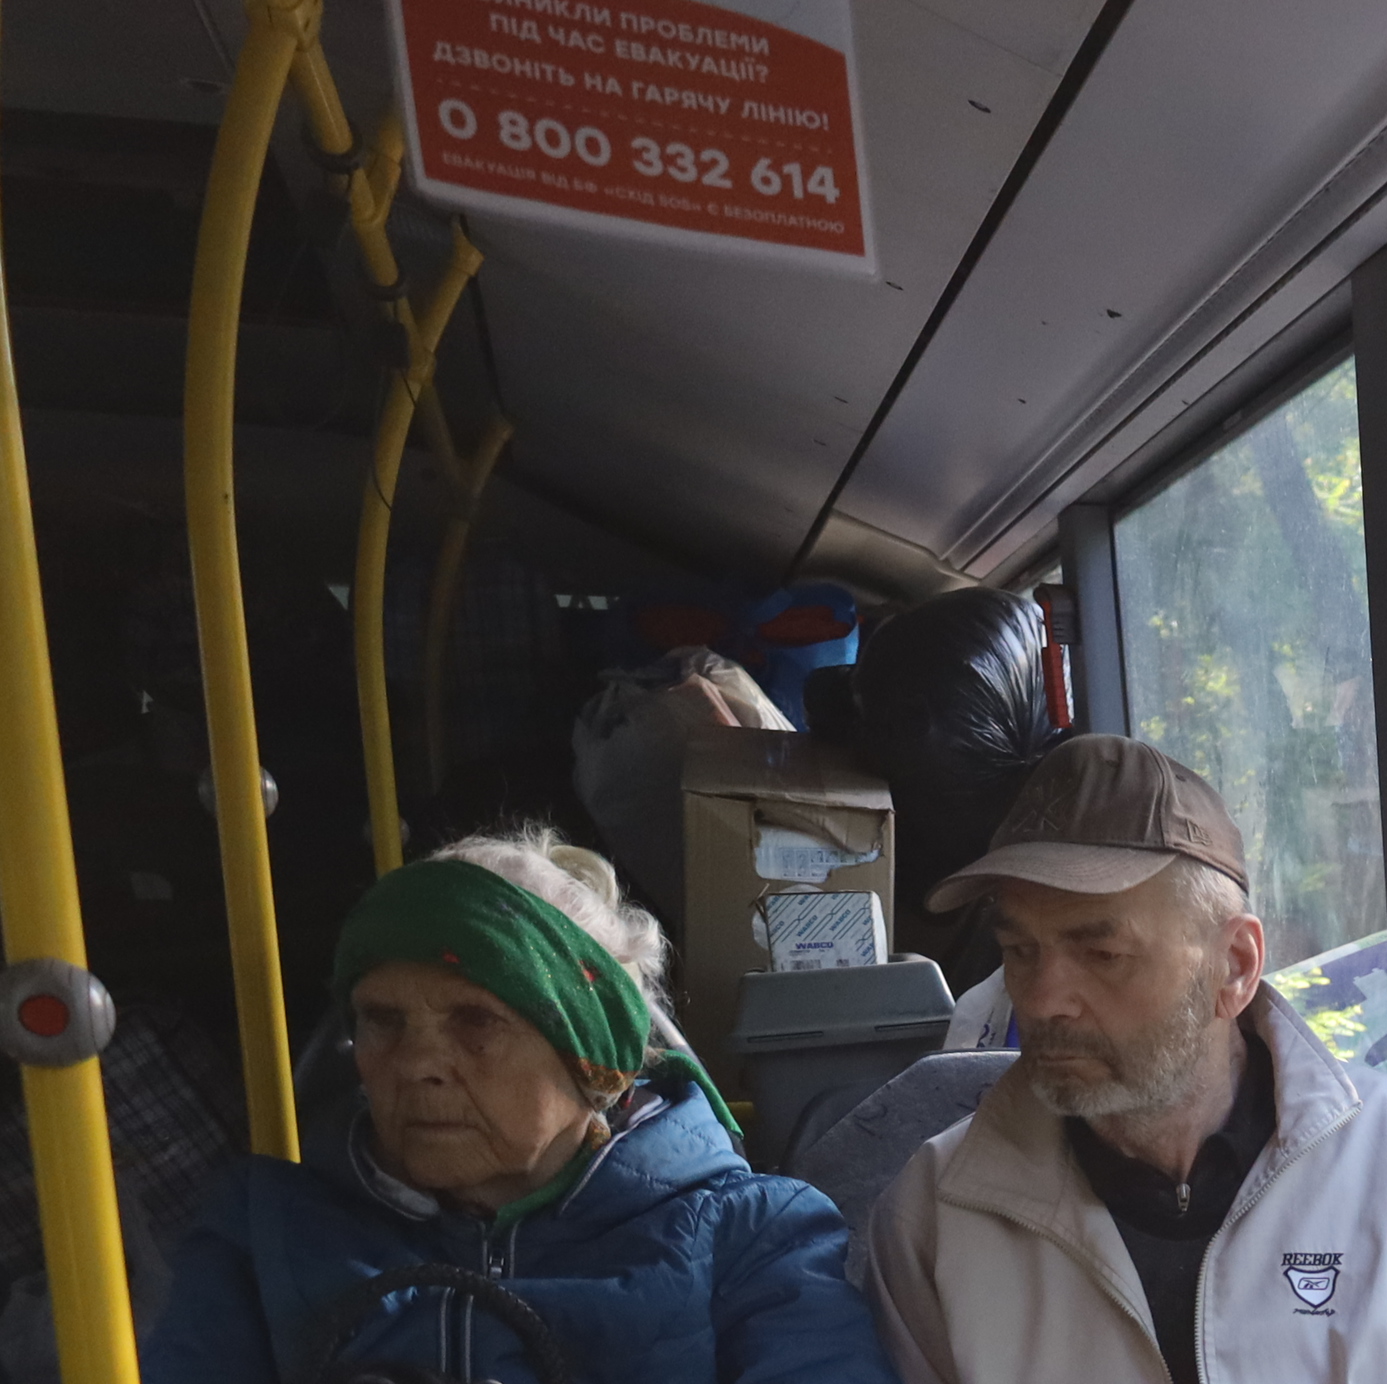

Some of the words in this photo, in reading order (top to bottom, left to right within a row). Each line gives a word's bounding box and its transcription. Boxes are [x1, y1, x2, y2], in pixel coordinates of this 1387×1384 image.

[489, 12, 542, 44] ПІД
[548, 24, 606, 54] ЧАС
[614, 38, 770, 84] ЕВАКУАЦІЇ?
[620, 12, 770, 56] ПРОБЛЕМИ
[433, 40, 576, 87] ДЗВОНІТЬ
[583, 71, 623, 97] НА
[632, 80, 730, 115] ГАРЯЧУ
[741, 100, 830, 131] ЛІНІЮ!
[438, 99, 478, 140] 0
[498, 110, 612, 168] 800
[630, 137, 733, 190] 332
[750, 156, 840, 205] 614
[795, 941, 834, 950] WABCO
[1281, 1252, 1344, 1267] REEBOK
